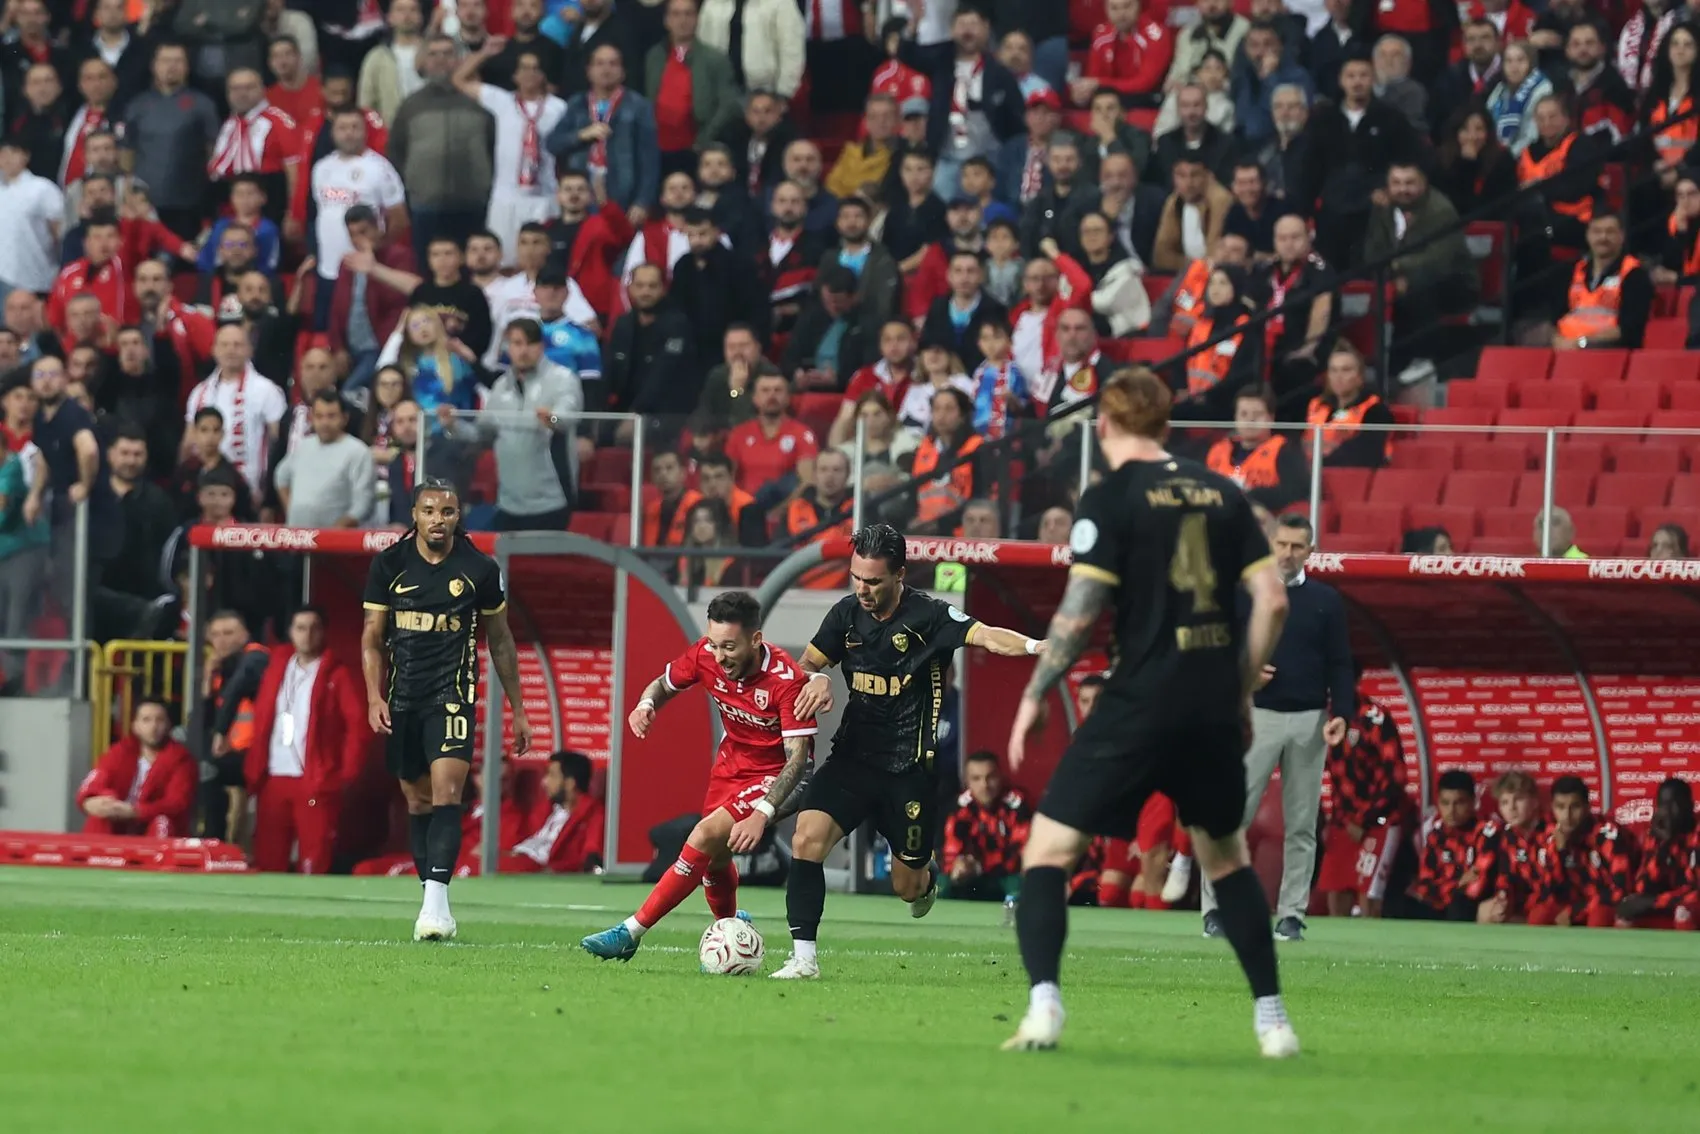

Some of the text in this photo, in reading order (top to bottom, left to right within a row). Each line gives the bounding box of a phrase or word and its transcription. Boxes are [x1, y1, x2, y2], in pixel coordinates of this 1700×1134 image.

[212, 526, 319, 549] MEDICALPARK
[1169, 512, 1221, 613] 4
[1409, 555, 1526, 577] MEDICALPARK
[444, 715, 468, 740] 10
[906, 825, 922, 851] 8
